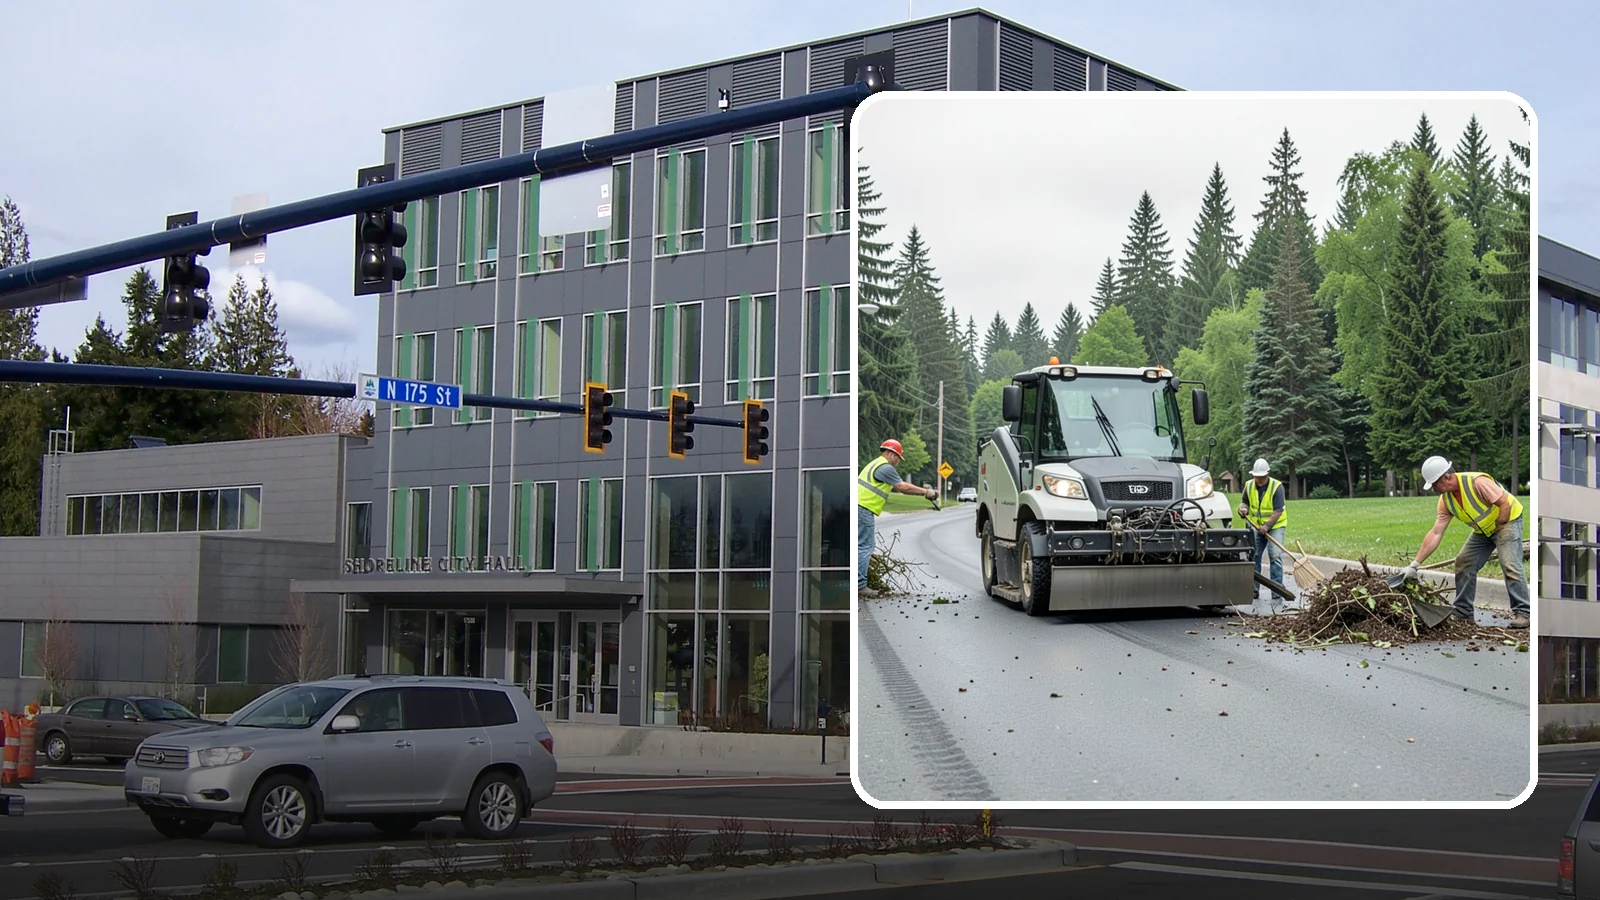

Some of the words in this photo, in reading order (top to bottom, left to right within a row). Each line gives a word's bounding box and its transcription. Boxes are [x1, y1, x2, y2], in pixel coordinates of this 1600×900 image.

[387, 380, 396, 400] N
[405, 382, 427, 403] 175
[436, 386, 451, 406] St
[344, 557, 432, 574] SHORELINE
[438, 557, 475, 572] CITY
[483, 555, 525, 571] HALL
